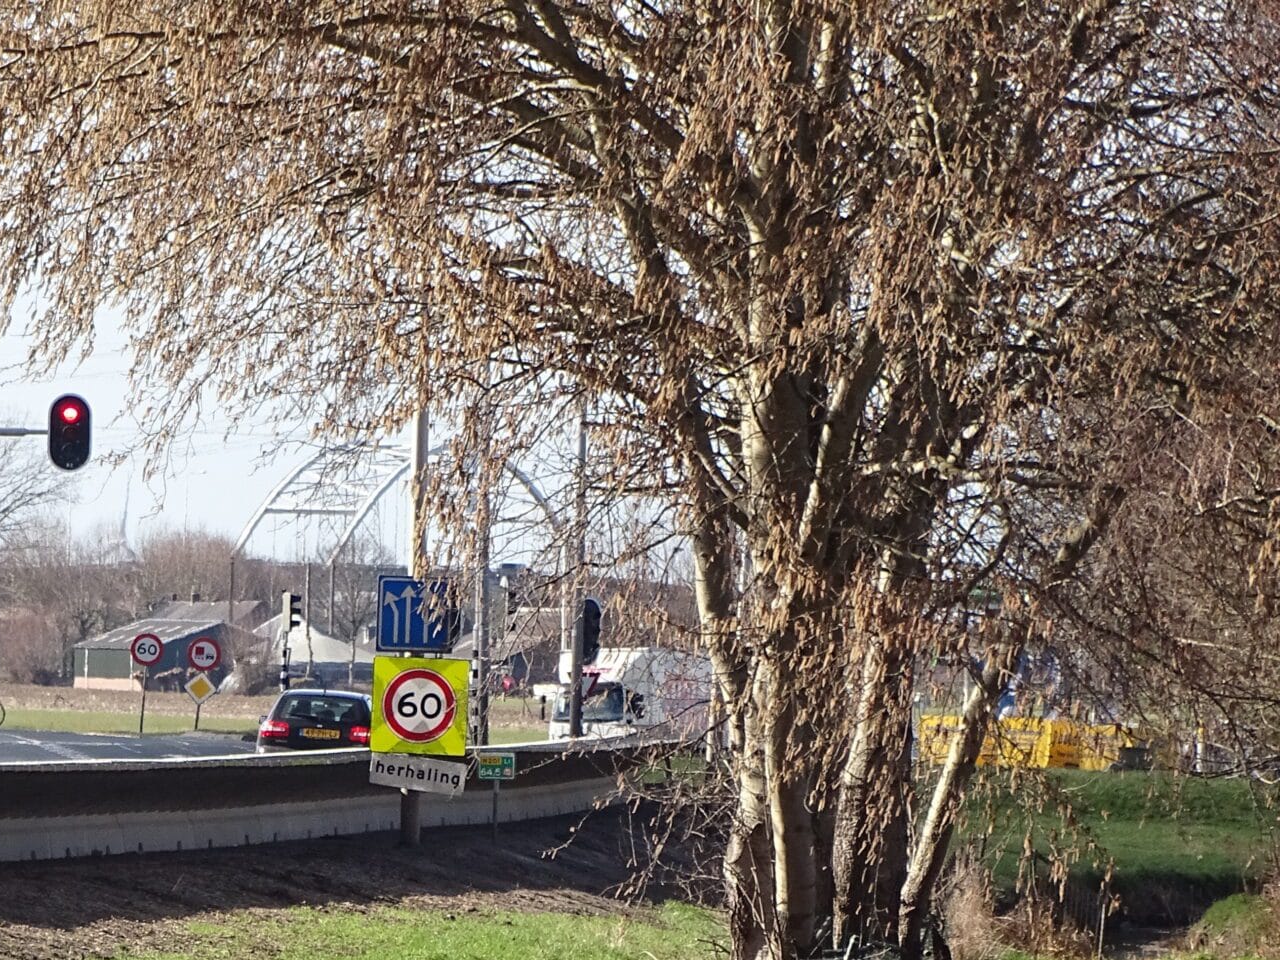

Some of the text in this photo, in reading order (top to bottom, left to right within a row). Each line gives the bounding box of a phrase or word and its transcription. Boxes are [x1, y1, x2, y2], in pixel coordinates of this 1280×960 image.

[137, 643, 158, 656] 60
[397, 692, 442, 719] 60
[375, 761, 461, 789] herhaling
